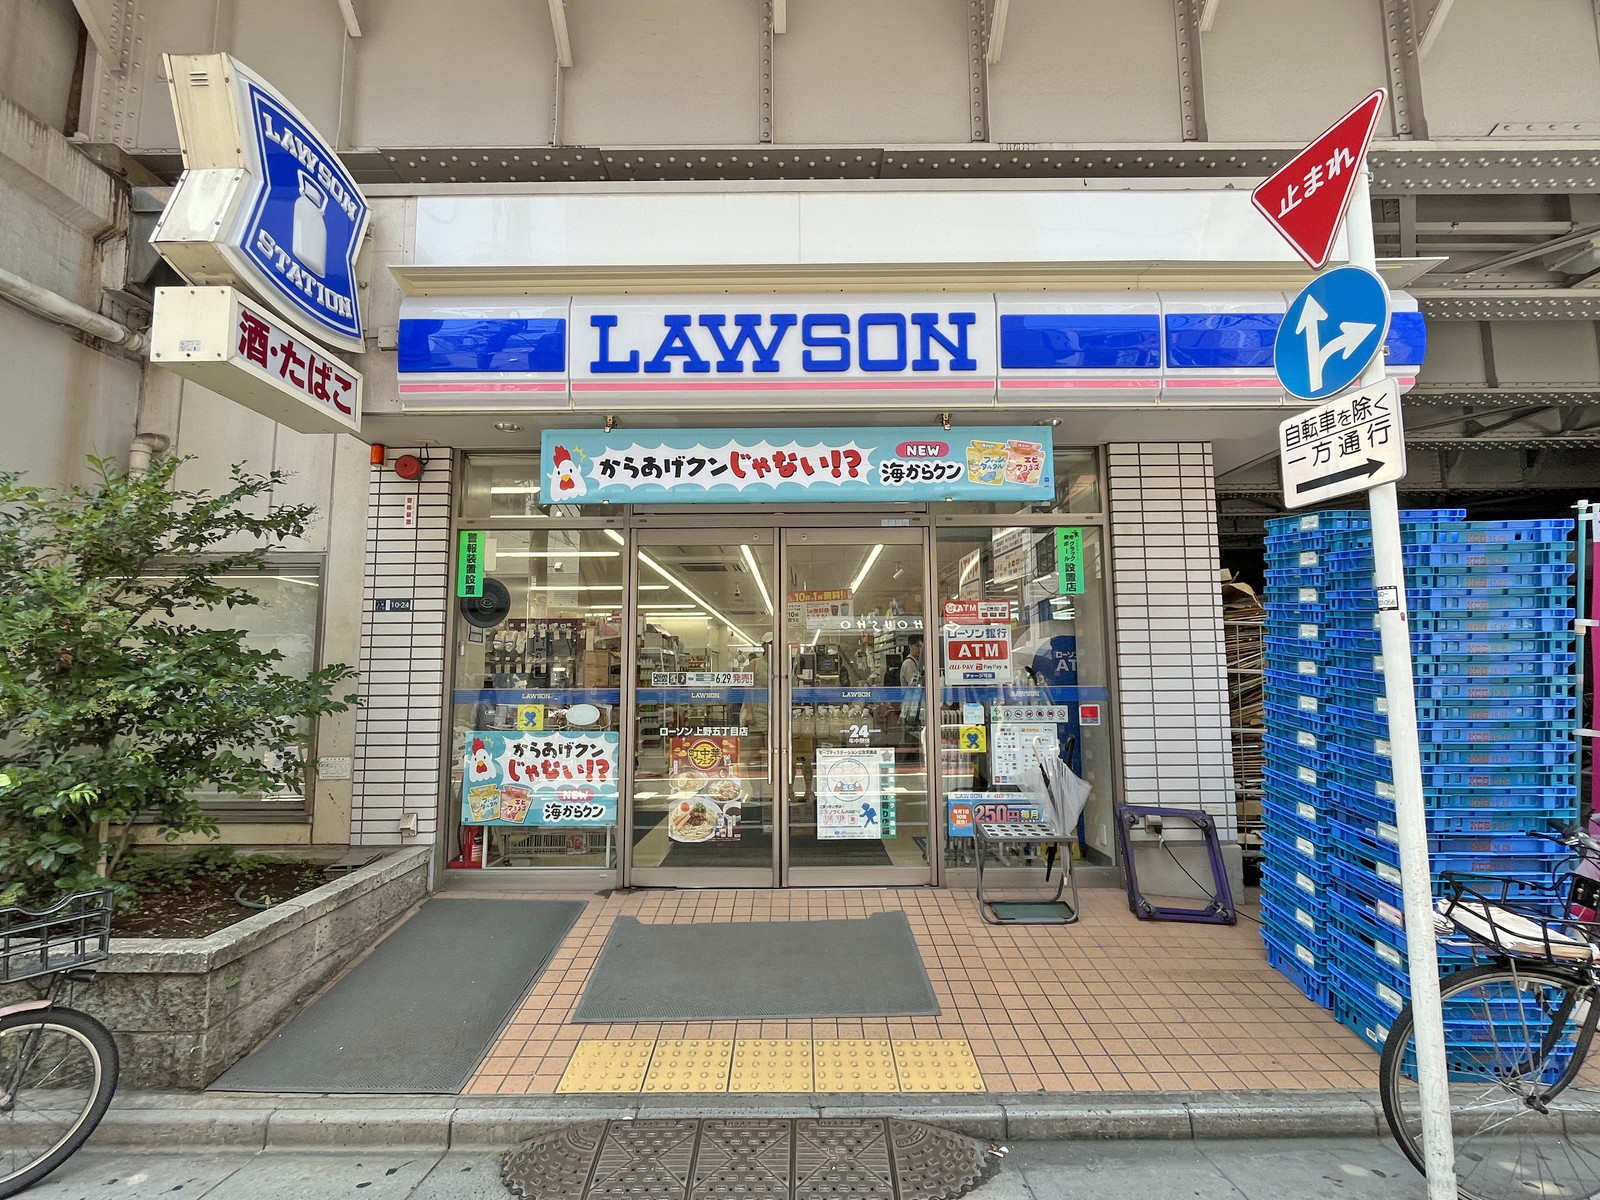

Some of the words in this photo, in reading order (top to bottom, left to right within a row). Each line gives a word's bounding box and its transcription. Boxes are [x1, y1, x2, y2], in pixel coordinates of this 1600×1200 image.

[263, 111, 357, 222] LAWSON
[1277, 147, 1355, 219] 止まれ
[256, 228, 353, 319] STATION
[590, 313, 977, 374] LAWSON
[238, 309, 352, 415] 酒・たばこ
[1285, 393, 1388, 447] 自転車を除く
[906, 445, 940, 456] NEW
[1288, 419, 1391, 467] 一方通行
[600, 450, 861, 479] からあげクンじゃない!?
[881, 461, 962, 482] 海からクン
[1065, 563, 1076, 592] 設置店
[948, 628, 1007, 639] ローソン銀行
[958, 643, 999, 657] ATM
[849, 725, 869, 737] 24
[513, 742, 604, 758] からあげクン
[689, 748, 722, 759] 町中華
[509, 759, 610, 782] じゃない!?
[544, 803, 604, 819] 海からクン
[1020, 809, 1039, 820] 毎月
